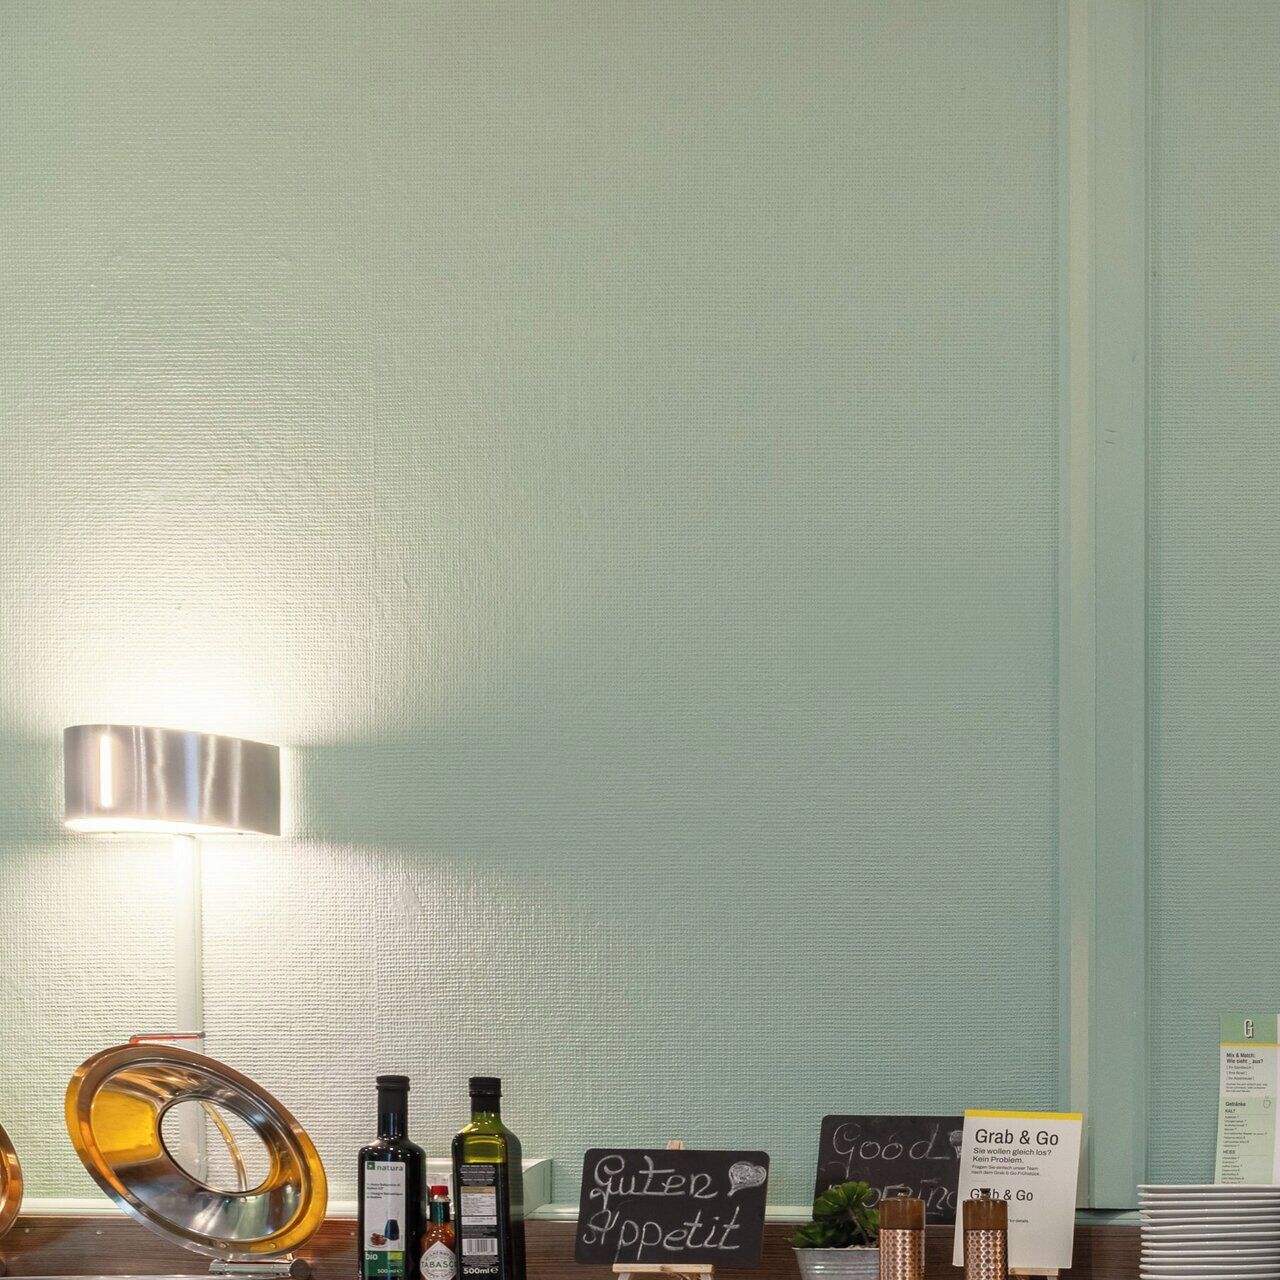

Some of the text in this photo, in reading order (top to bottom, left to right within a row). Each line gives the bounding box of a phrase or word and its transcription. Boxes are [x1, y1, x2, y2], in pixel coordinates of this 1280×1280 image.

[975, 1129, 1059, 1145] Grab & Go
[1012, 1148, 1034, 1156] gleich
[590, 1155, 718, 1210] Guten
[970, 1188, 1033, 1201] Gb & Go
[421, 1260, 456, 1269] TABASC
[463, 1267, 489, 1275] 500ml
